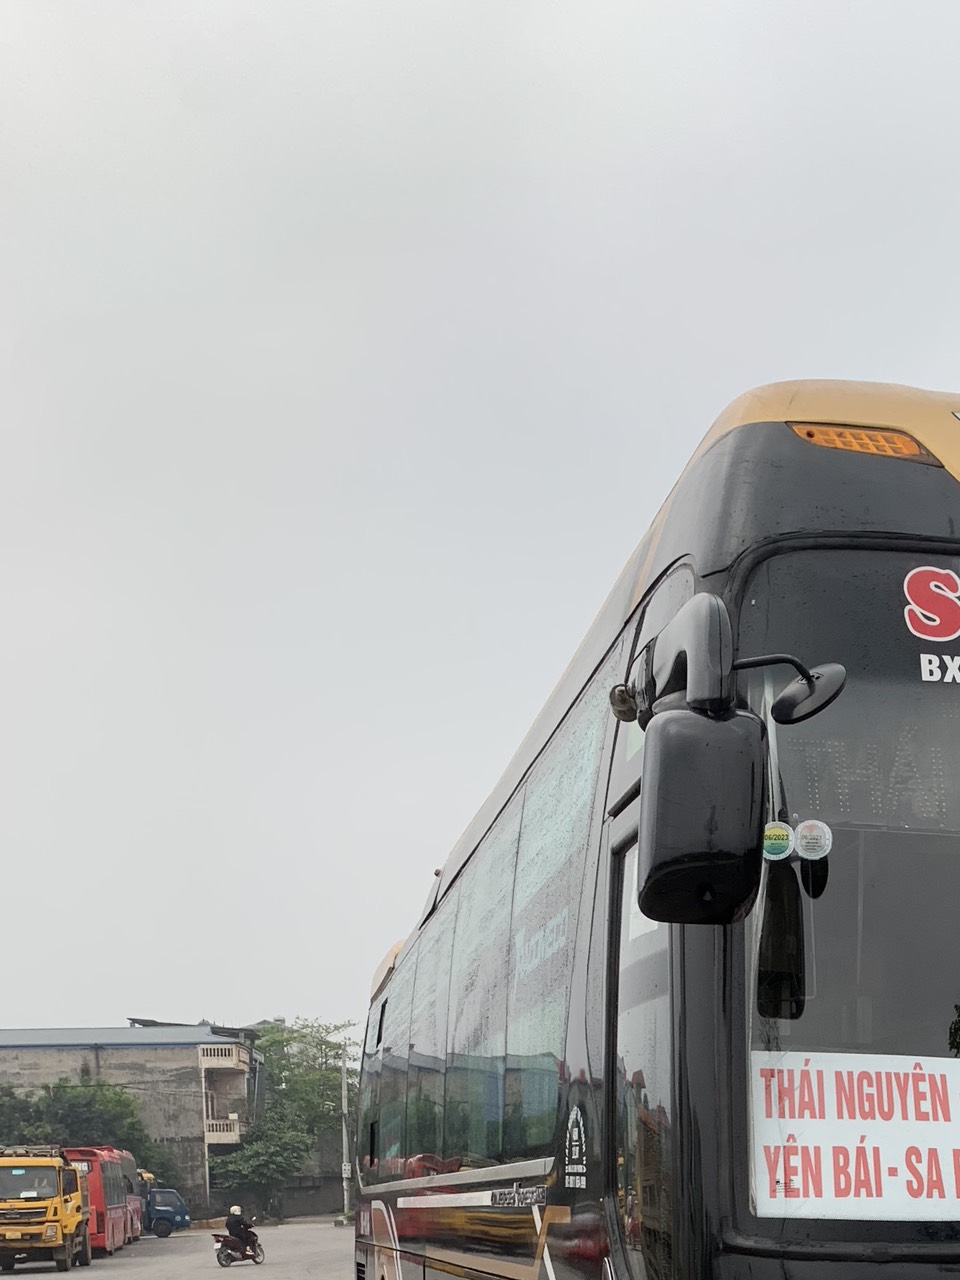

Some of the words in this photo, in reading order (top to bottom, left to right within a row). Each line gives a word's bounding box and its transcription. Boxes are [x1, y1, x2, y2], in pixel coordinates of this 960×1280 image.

[760, 1059, 825, 1119] THÁI
[834, 1063, 951, 1122] NGUYÊN
[763, 1134, 823, 1199] YÊN
[905, 1146, 946, 1199] SA
